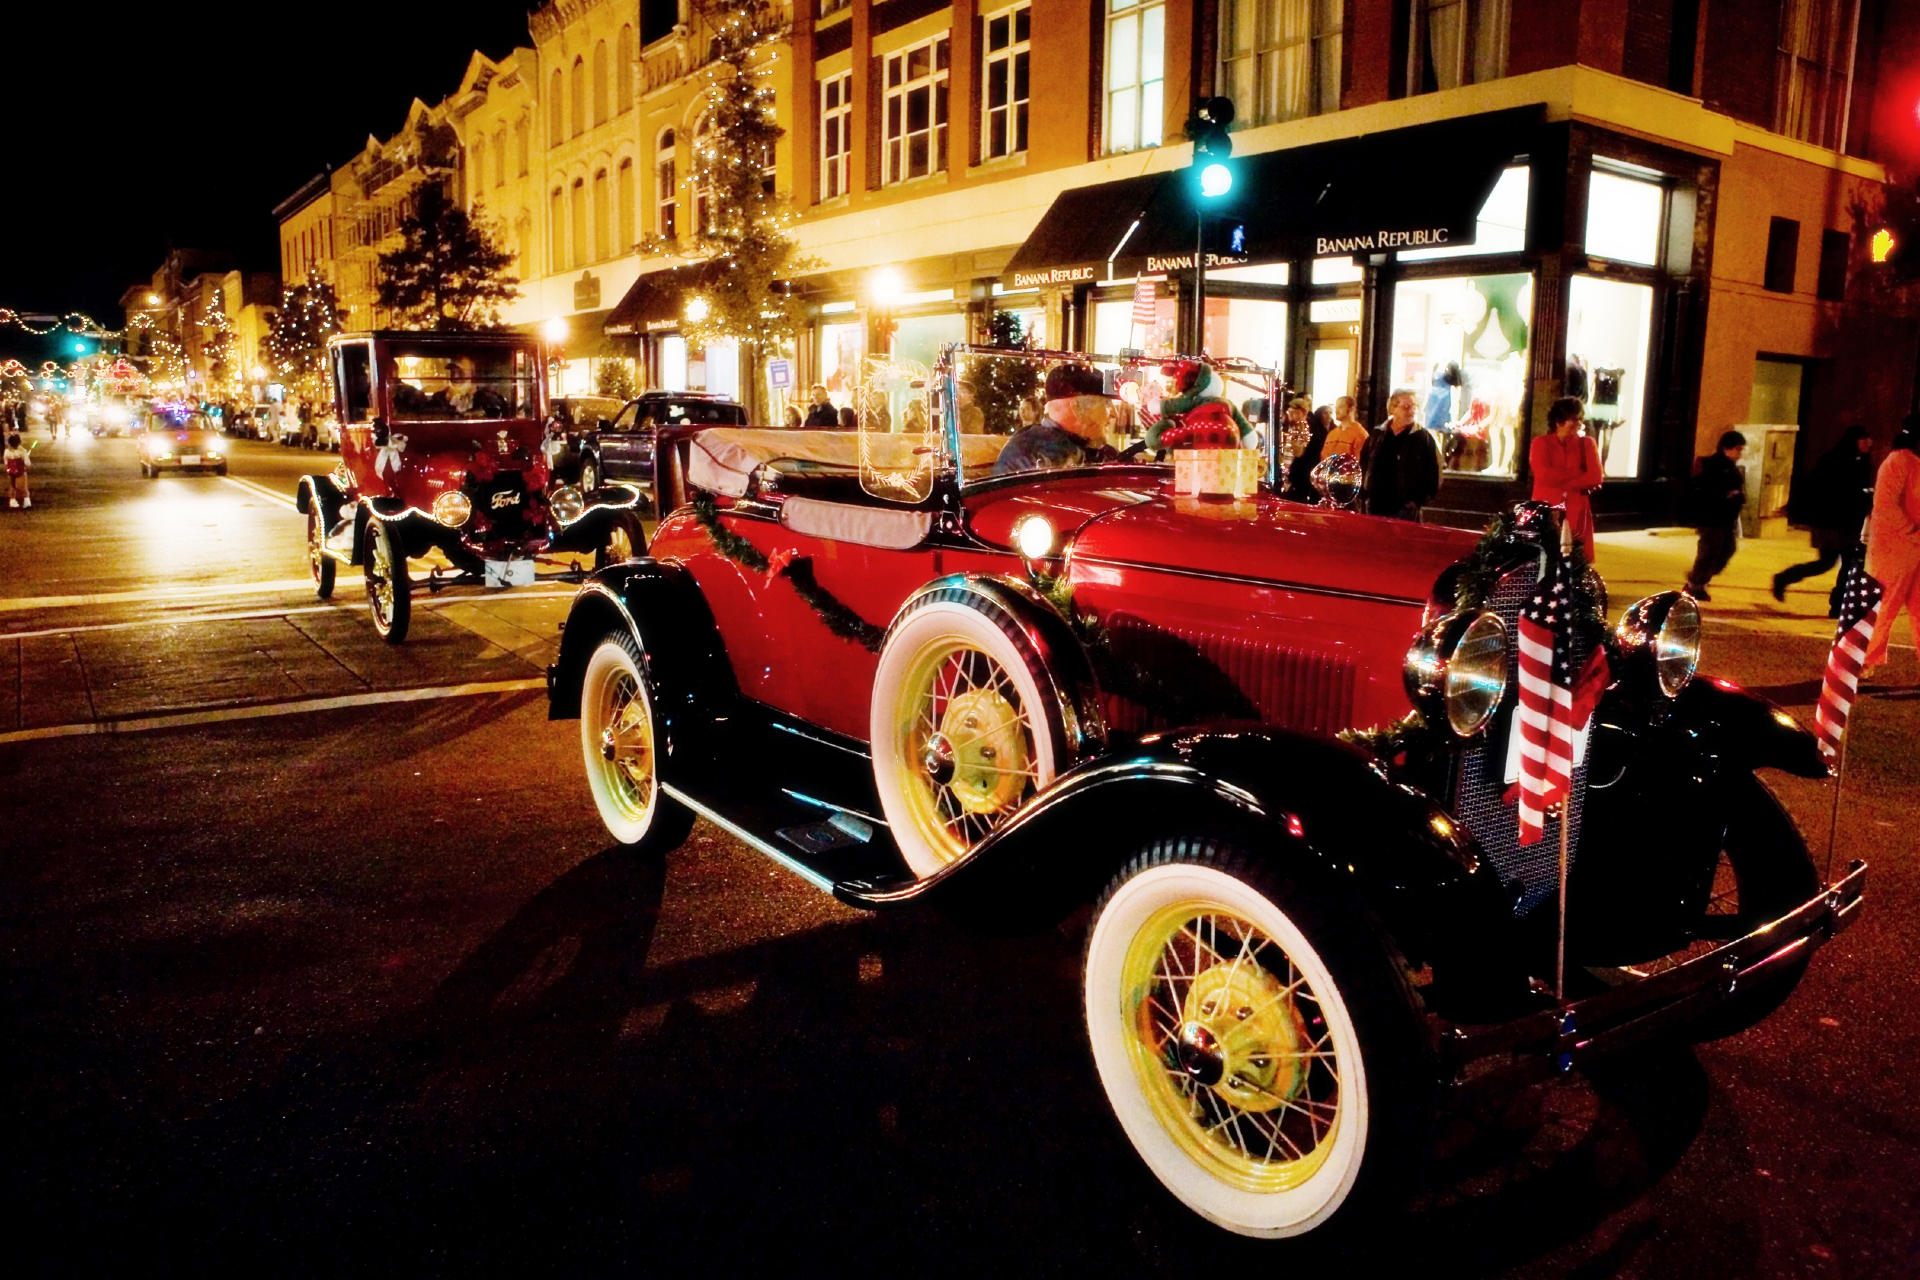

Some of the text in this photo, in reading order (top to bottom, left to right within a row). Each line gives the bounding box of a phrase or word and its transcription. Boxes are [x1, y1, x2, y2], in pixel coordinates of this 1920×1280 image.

[1316, 227, 1449, 255] BANANA REPUBLIC
[1147, 256, 1193, 272] BANANA
[1014, 267, 1094, 287] BANANA REPUBLIC
[491, 489, 521, 510] Ford
